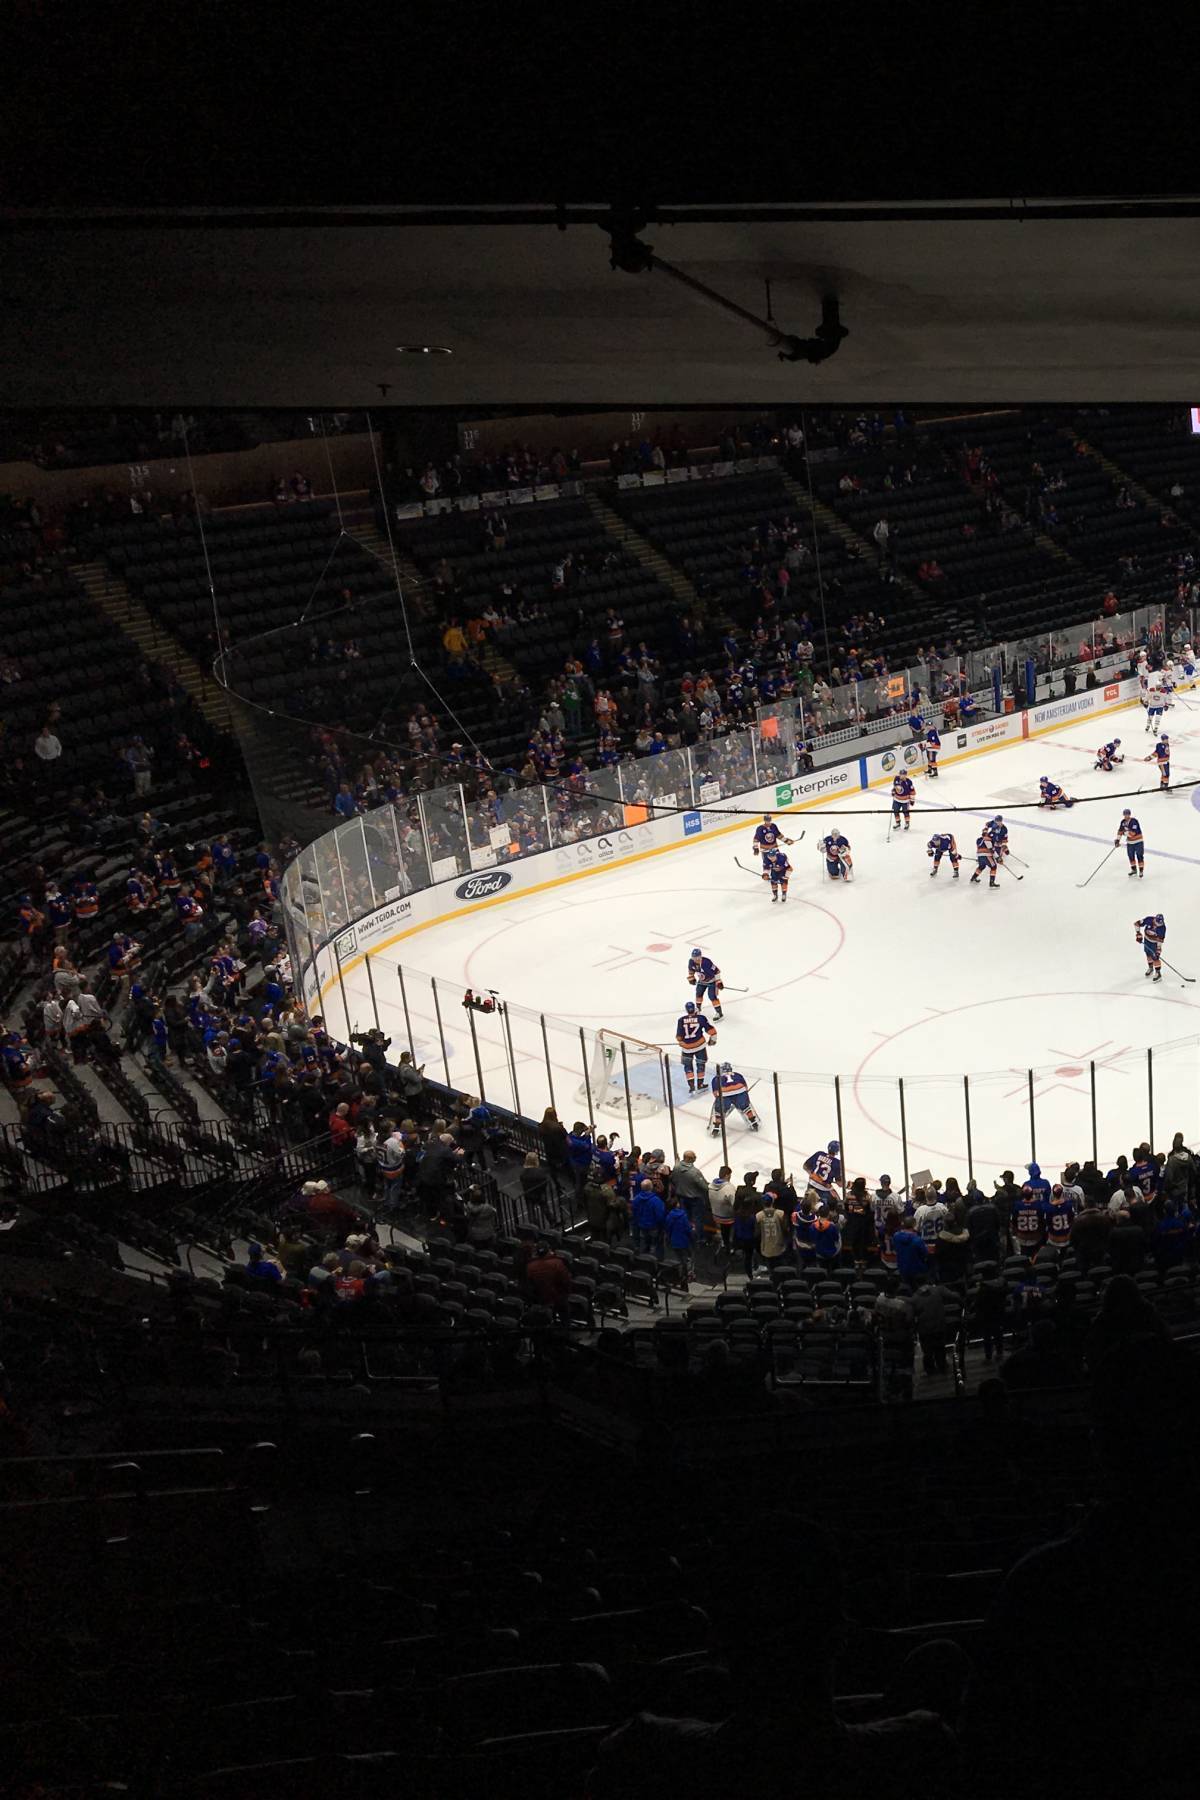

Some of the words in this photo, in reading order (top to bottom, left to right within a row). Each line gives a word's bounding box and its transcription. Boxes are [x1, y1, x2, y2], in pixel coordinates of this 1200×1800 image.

[1105, 690, 1118, 698] TCL
[1034, 712, 1046, 723] NEW
[1046, 702, 1077, 720] AMSTERDAM
[1078, 697, 1094, 710] VODKA
[780, 772, 848, 800] enterprise
[685, 818, 700, 828] HSS
[464, 874, 503, 899] Ford
[358, 902, 412, 934] WWW.TGIDA.COM
[683, 1023, 700, 1039] 17
[813, 1160, 832, 1182] 13
[1017, 1215, 1039, 1231] 26
[1052, 1214, 1070, 1231] 91
